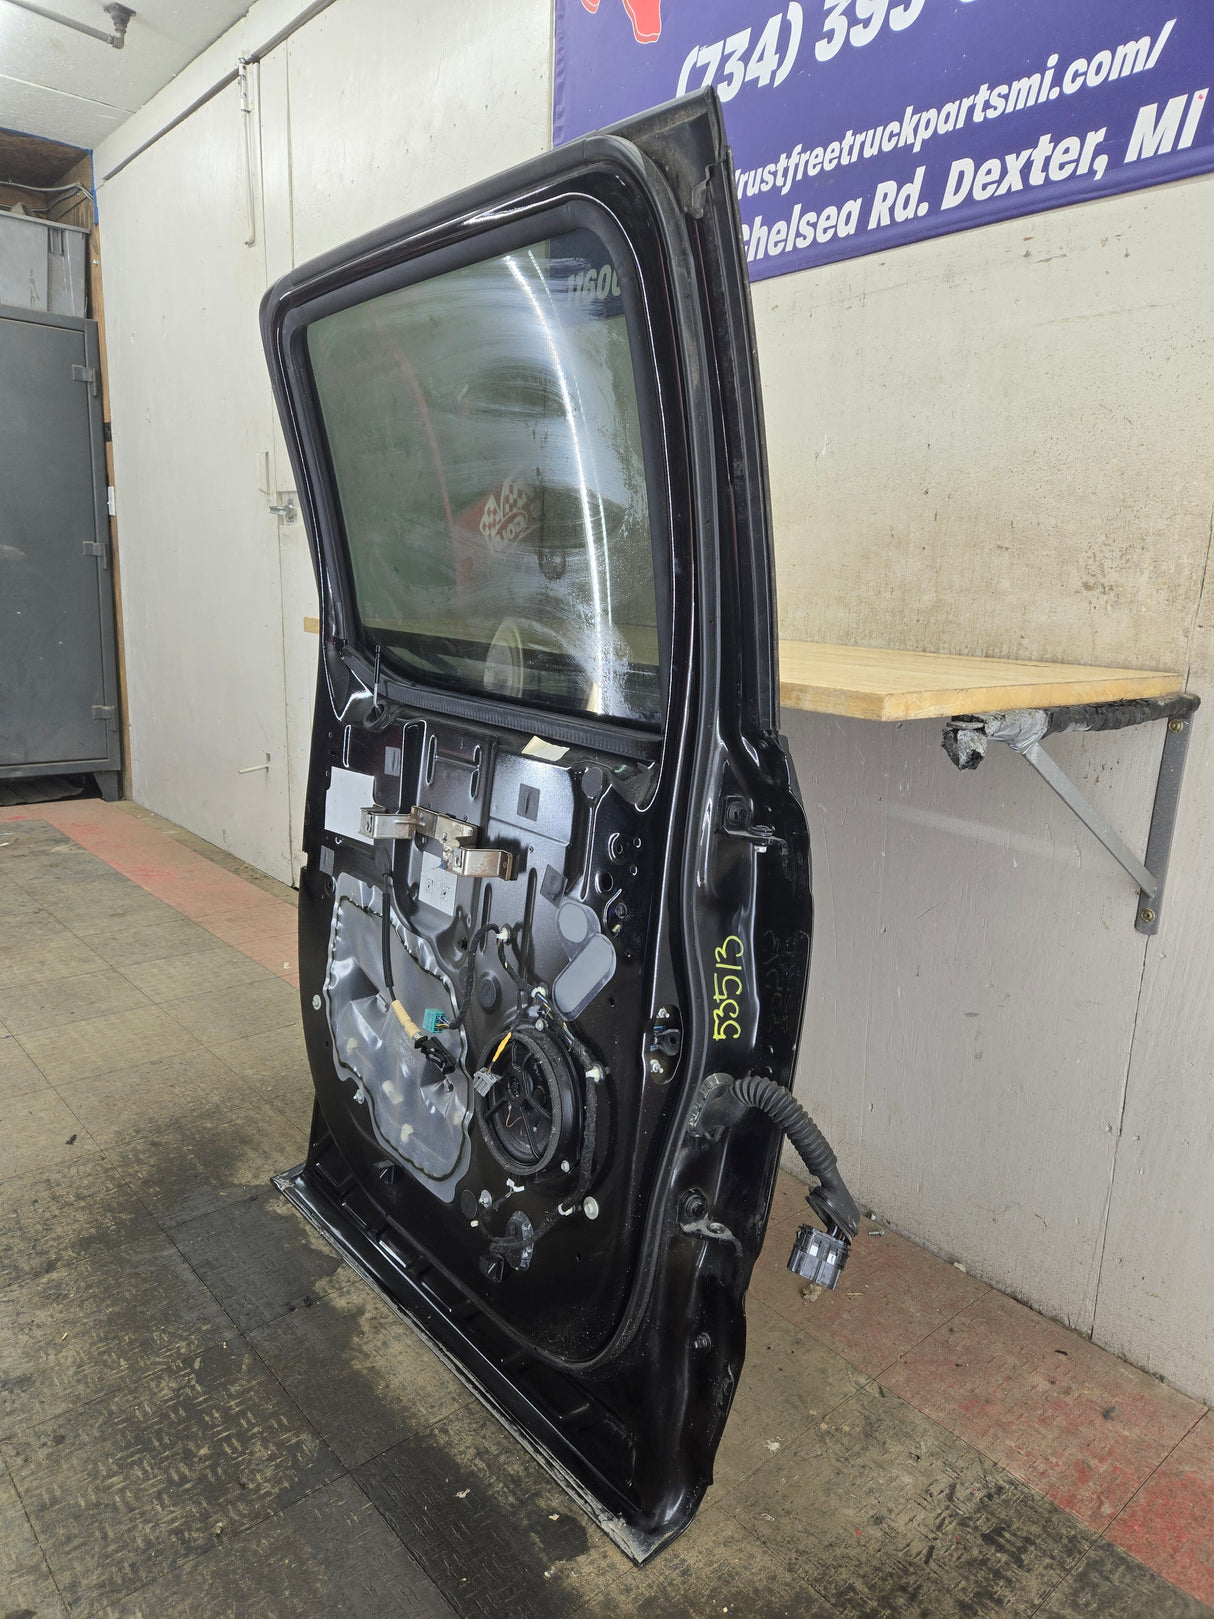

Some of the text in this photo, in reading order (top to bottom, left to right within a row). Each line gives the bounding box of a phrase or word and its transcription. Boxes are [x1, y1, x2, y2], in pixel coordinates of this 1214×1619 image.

[675, 1, 804, 103] (734)
[867, 165, 929, 231] Rd.
[940, 127, 1109, 211] Dexter,
[1124, 87, 1210, 164] MI
[712, 935, 744, 1042] 53513
